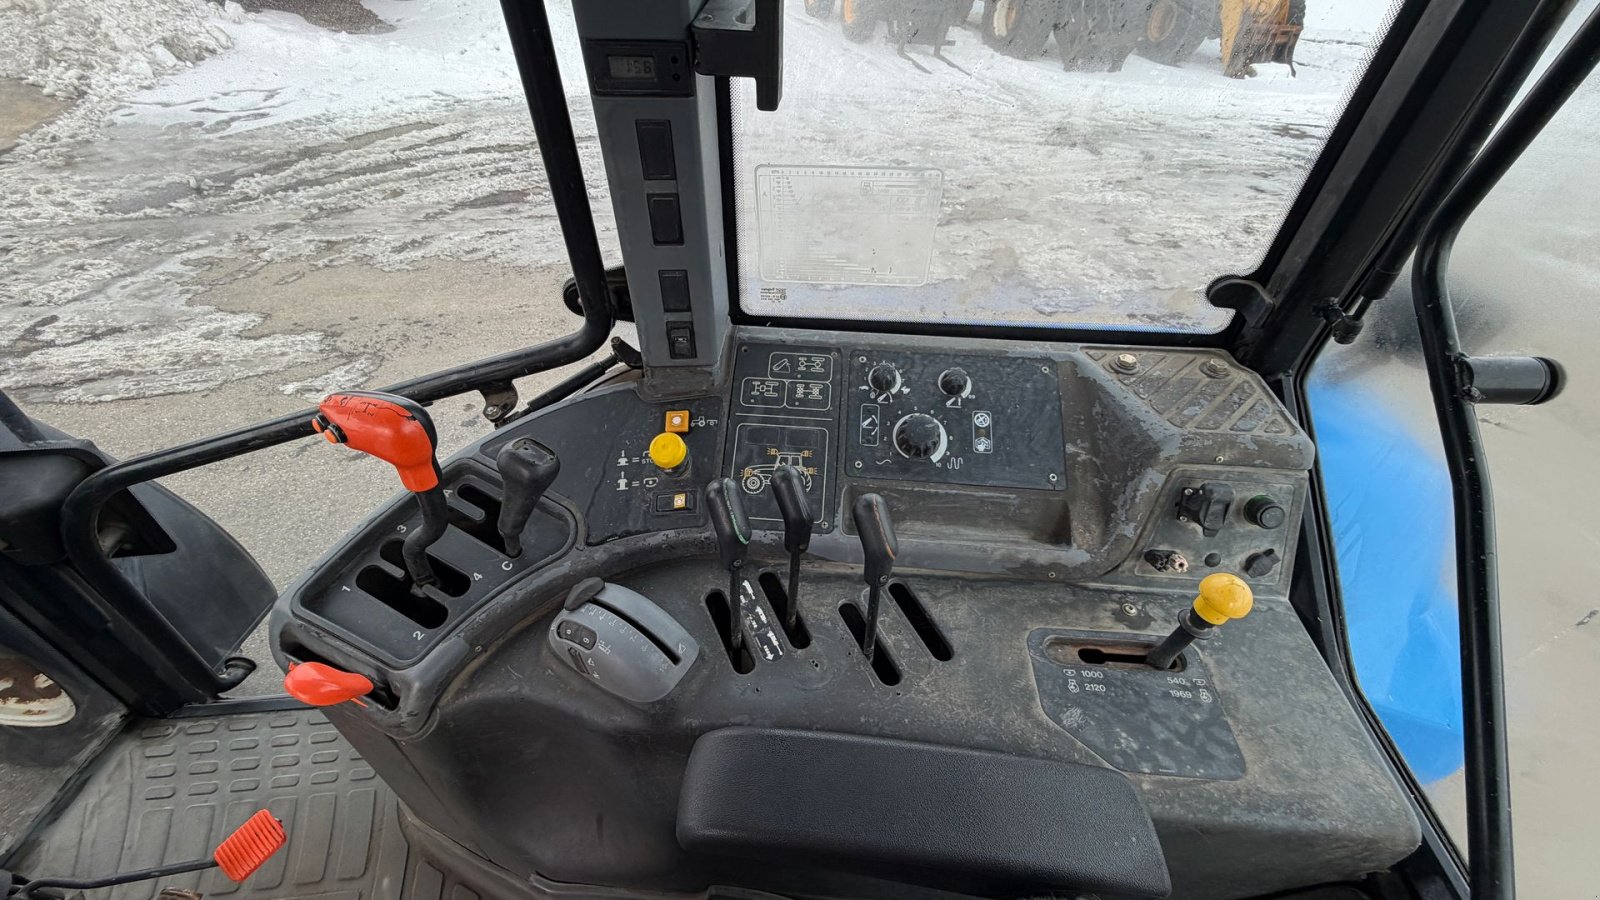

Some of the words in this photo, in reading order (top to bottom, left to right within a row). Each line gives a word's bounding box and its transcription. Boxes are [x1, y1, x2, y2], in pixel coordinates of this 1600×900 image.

[443, 489, 453, 498] A
[396, 524, 408, 534] 3
[501, 561, 513, 571] C
[473, 572, 484, 582] 4
[341, 585, 352, 593] 1
[413, 630, 425, 641] 2
[1080, 670, 1104, 679] 1000
[1167, 676, 1187, 685] 540
[1084, 683, 1106, 692] 2120
[1169, 689, 1192, 699] 1969
